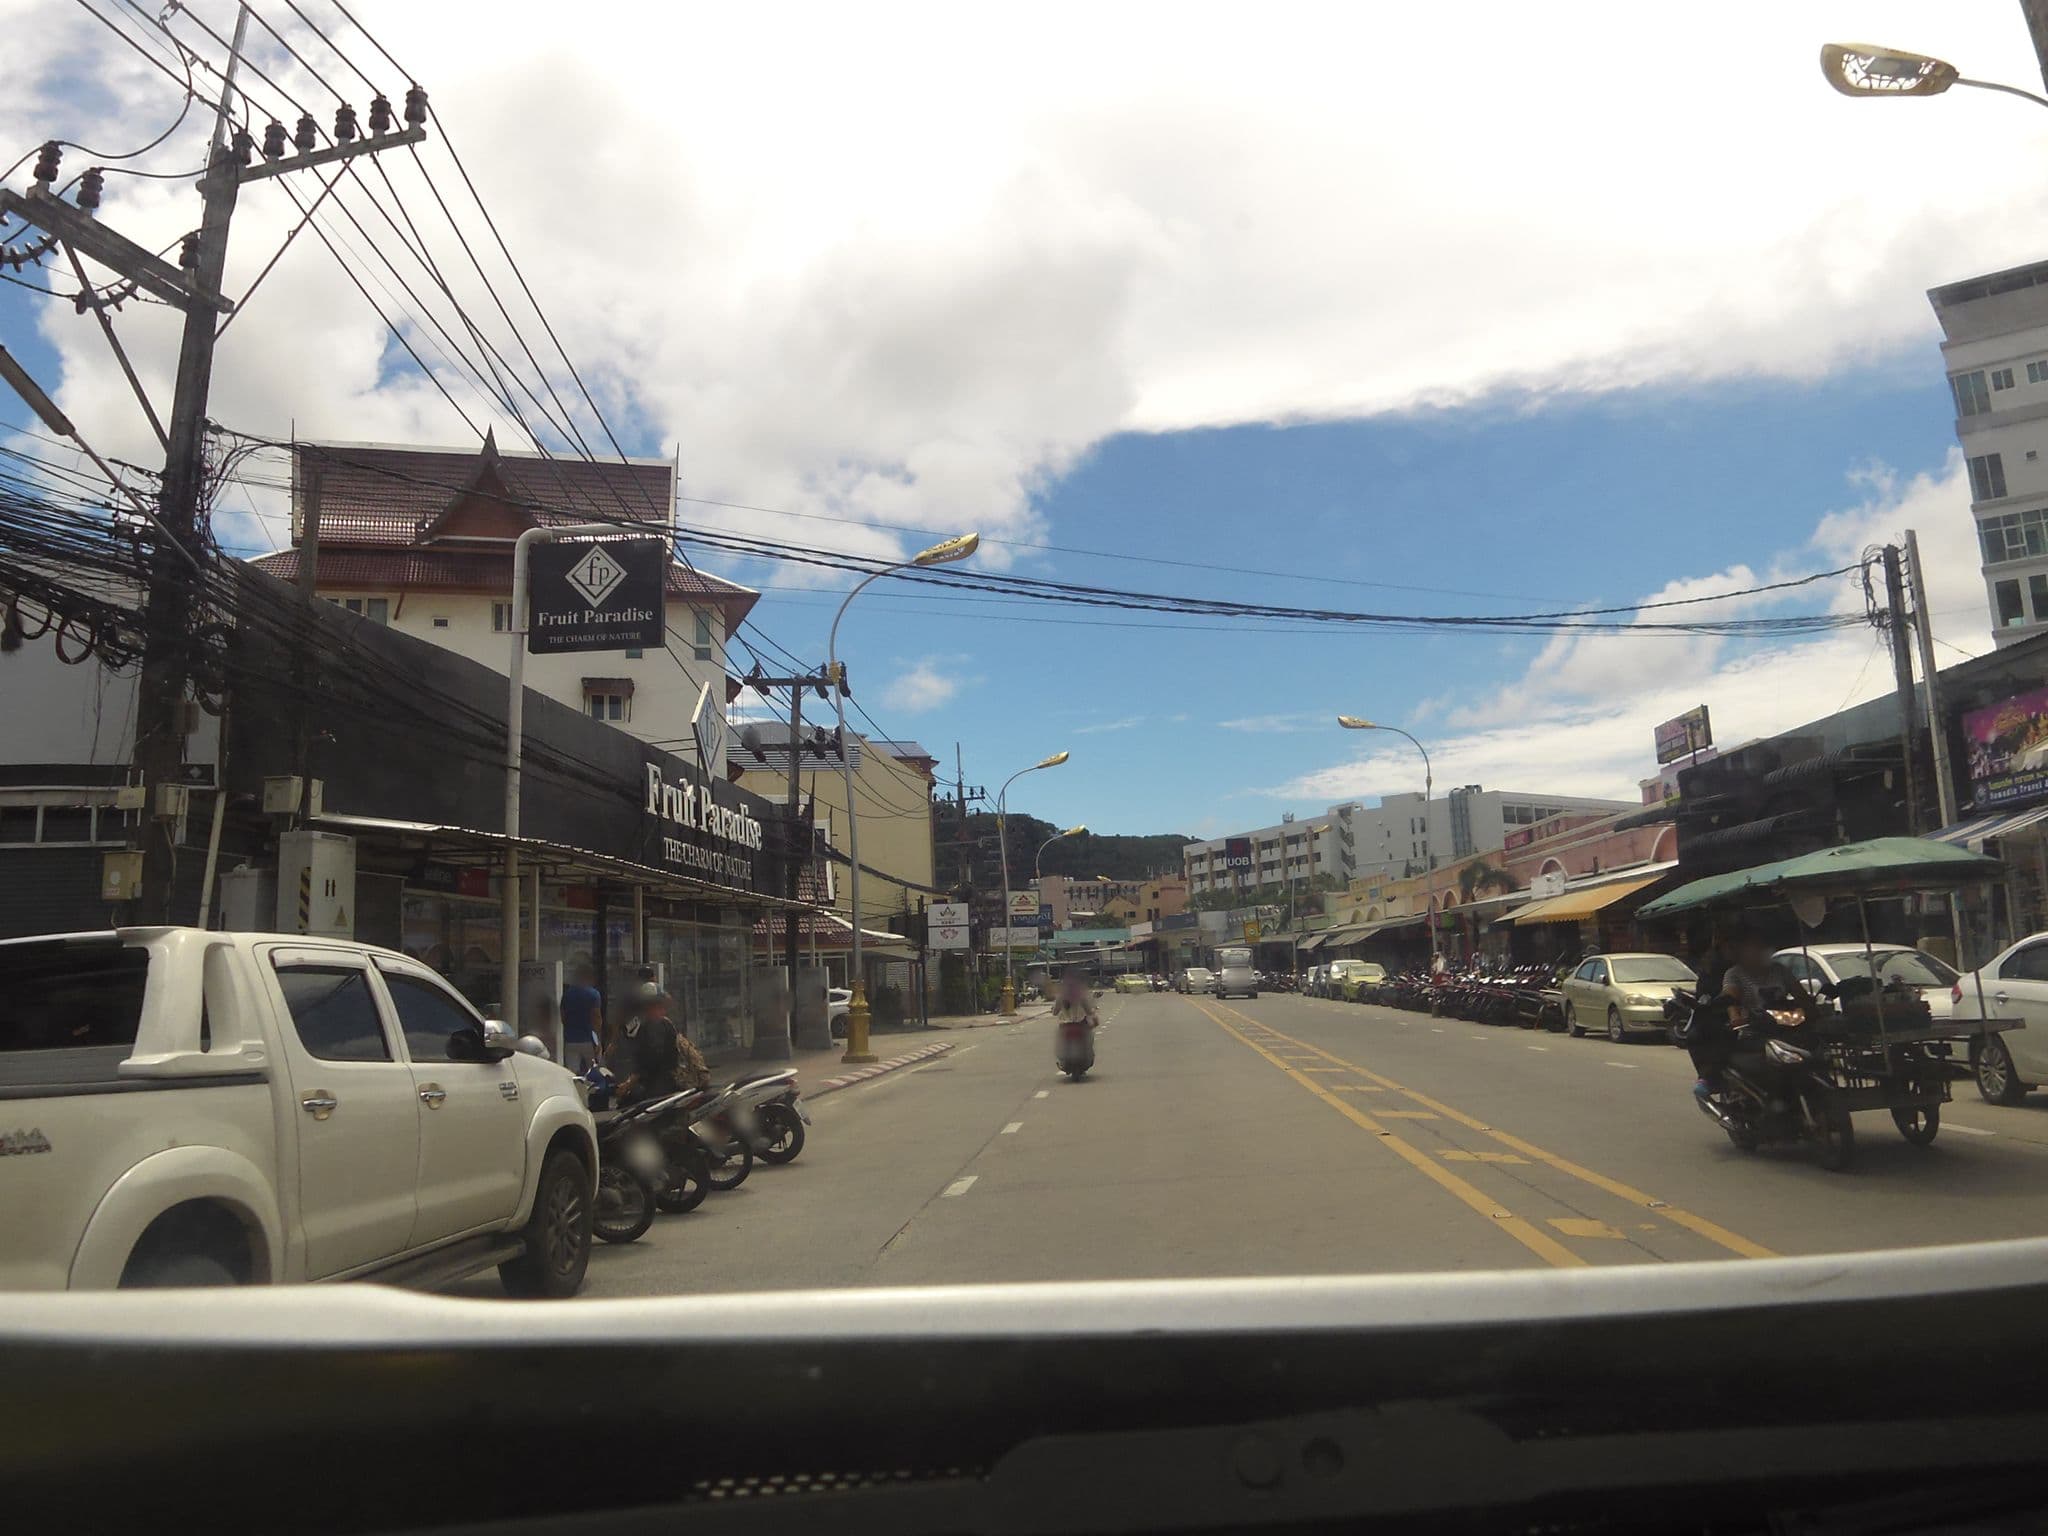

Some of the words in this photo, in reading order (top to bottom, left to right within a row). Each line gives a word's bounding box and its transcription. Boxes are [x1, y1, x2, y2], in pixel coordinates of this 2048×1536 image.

[538, 611, 579, 626] Fruit
[584, 608, 653, 624] Paradise
[549, 636, 564, 644] THE
[566, 634, 595, 643] CHARM
[596, 633, 608, 641] OF
[609, 632, 641, 641] NATURE
[645, 762, 697, 829] Fruit
[698, 785, 763, 851] Paradise
[664, 837, 682, 863] THE
[682, 842, 713, 872] CHARM
[713, 852, 724, 873] OF
[724, 853, 753, 881] NATURE
[1228, 857, 1249, 866] UOB
